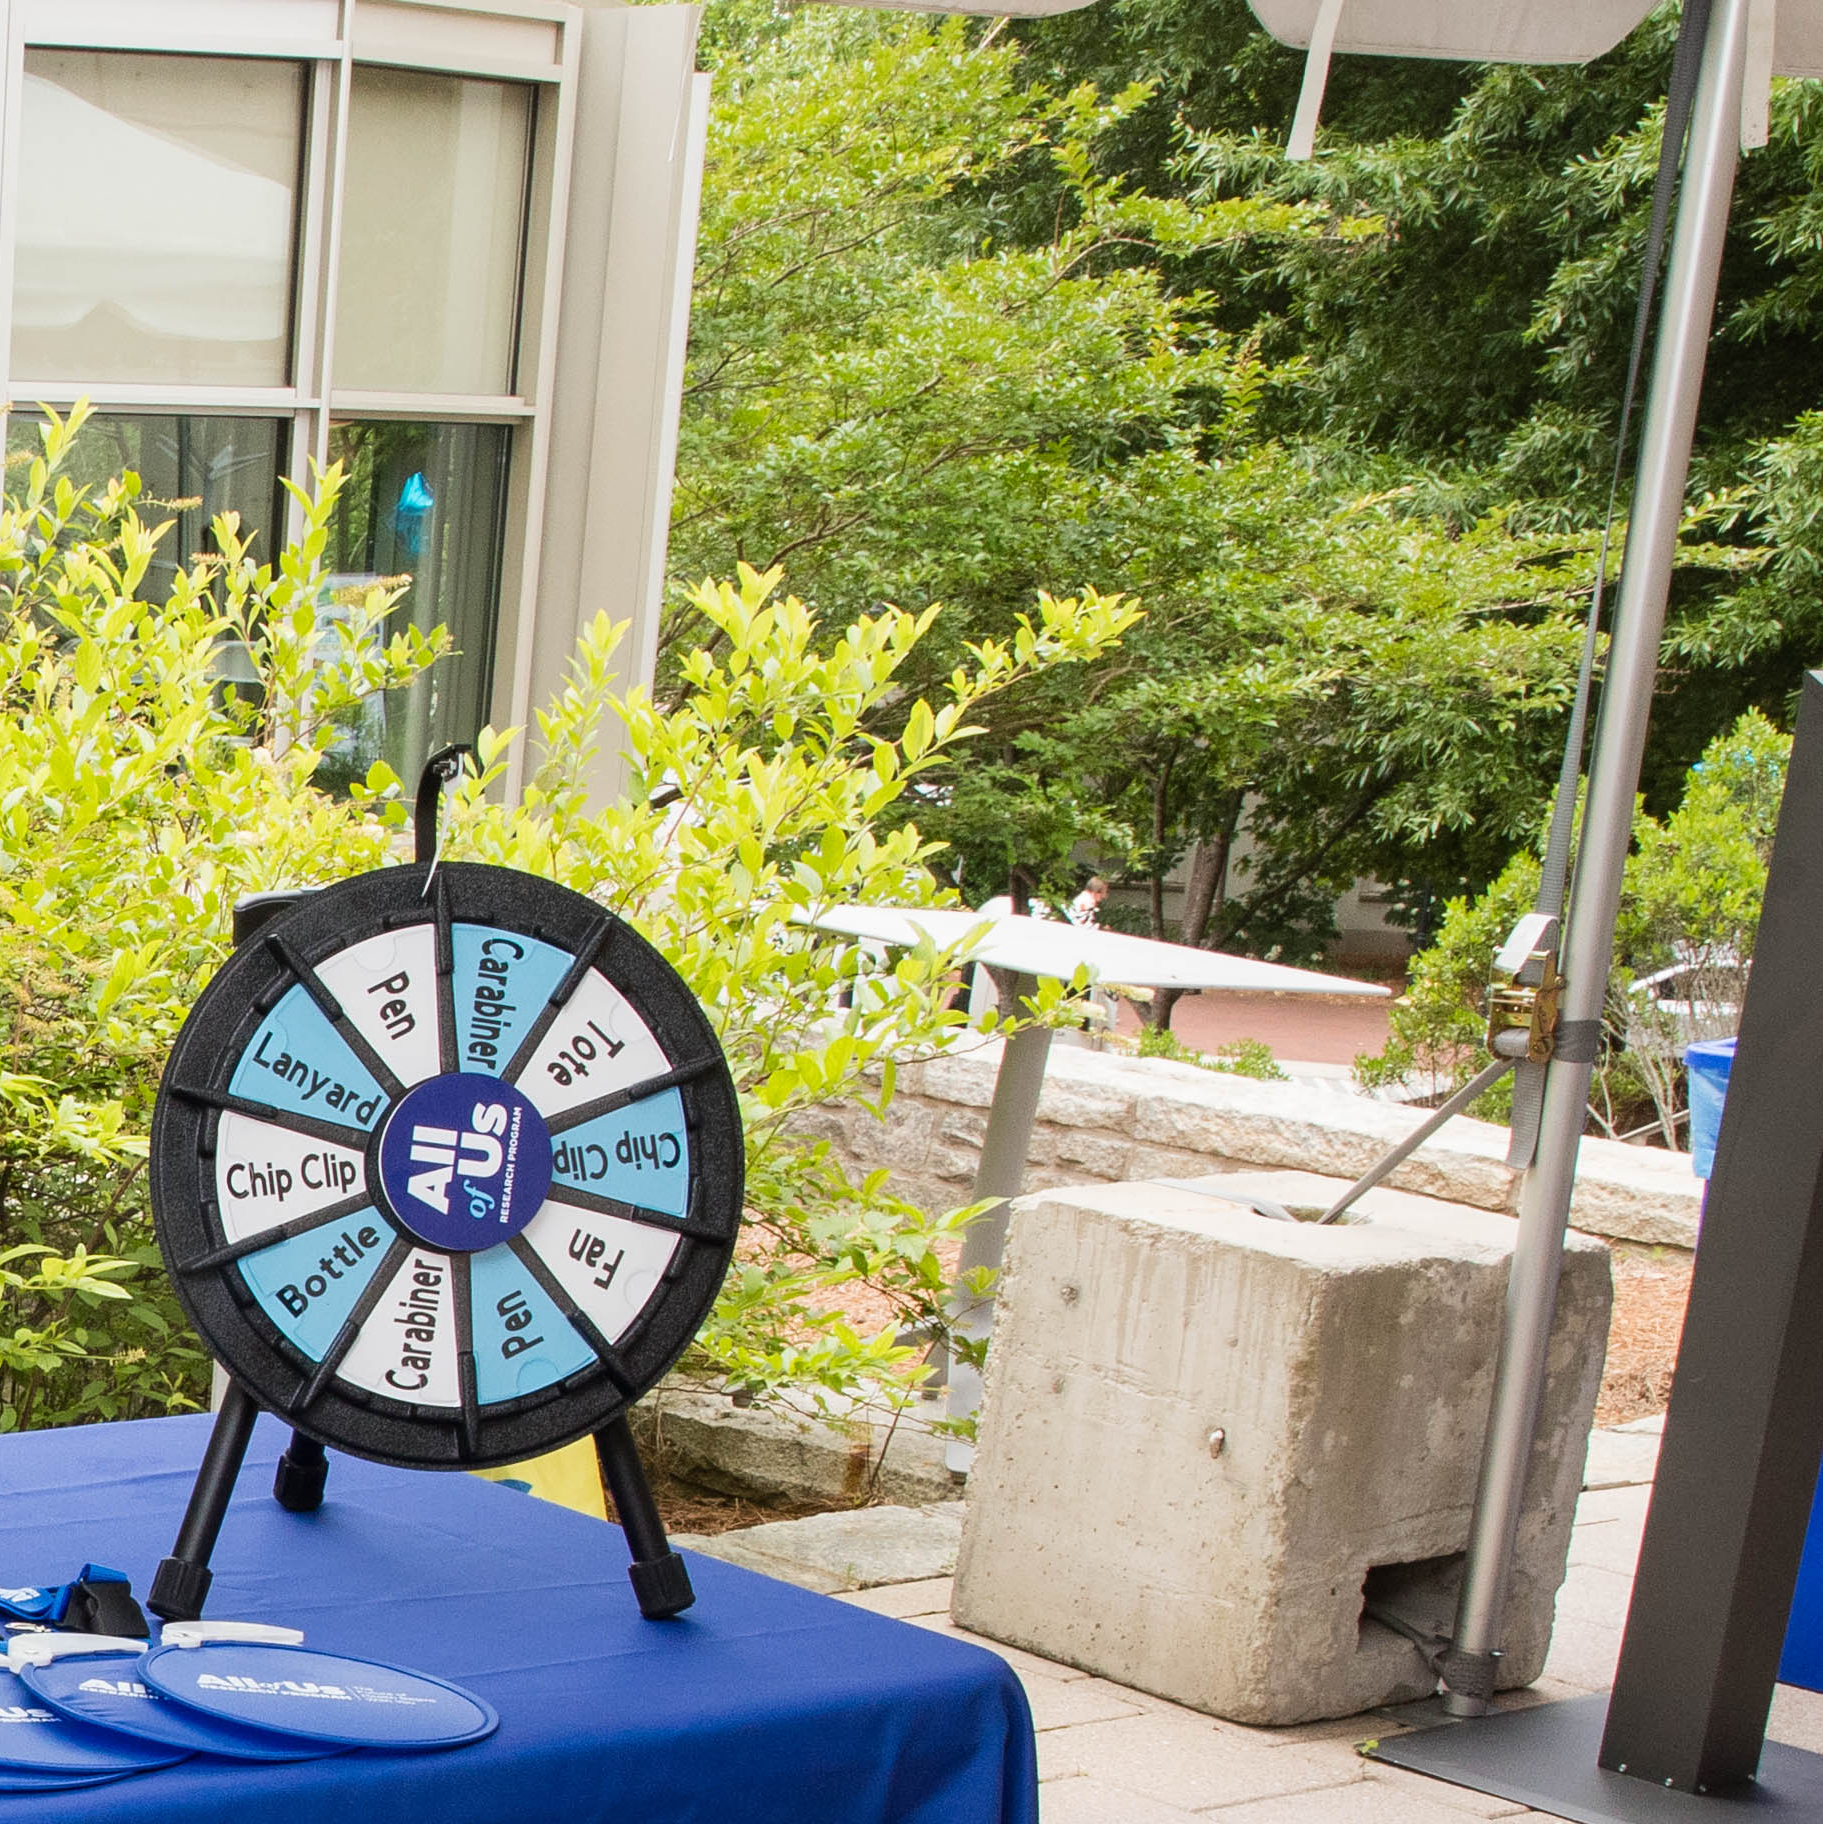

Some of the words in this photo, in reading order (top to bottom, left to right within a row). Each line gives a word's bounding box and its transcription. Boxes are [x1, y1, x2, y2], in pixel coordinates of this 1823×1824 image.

[367, 968, 418, 1042] Pen
[465, 937, 526, 1072] Carabiner
[252, 1030, 385, 1126] Lanyard
[546, 1019, 626, 1088] Tote
[457, 1102, 508, 1178] Us
[507, 1107, 523, 1162] PROGRAM
[552, 1142, 609, 1184] Clip
[615, 1132, 681, 1172] Chip
[226, 1161, 293, 1202] Chip
[301, 1152, 358, 1195] Clip
[407, 1125, 458, 1215] All
[463, 1179, 495, 1219] of
[500, 1163, 515, 1223] RESEARCH
[274, 1224, 381, 1319] Bottle
[568, 1226, 625, 1290] Fan
[385, 1257, 446, 1392] Carabiner
[501, 1288, 545, 1362] Pen
[197, 1674, 262, 1689] All
[282, 1681, 346, 1696] Us
[199, 1684, 278, 1694] RESEARCH
[280, 1690, 353, 1701] PROGRAM
